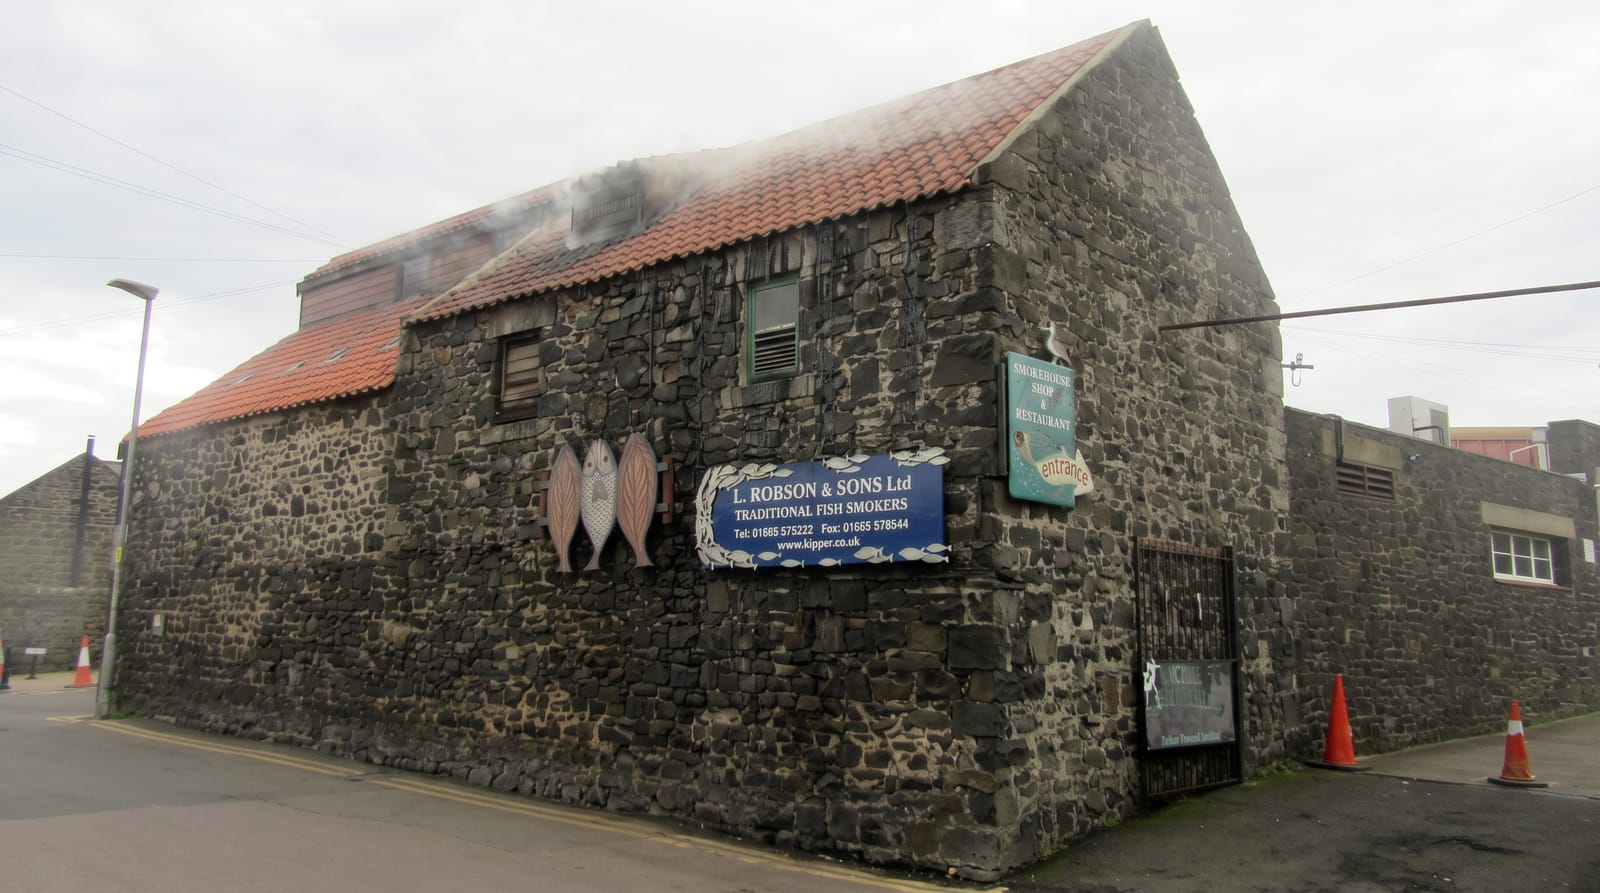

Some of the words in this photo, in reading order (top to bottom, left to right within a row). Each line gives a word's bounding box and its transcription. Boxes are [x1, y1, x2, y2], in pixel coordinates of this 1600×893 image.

[1014, 363, 1070, 387] SMOKEHOUSE
[1031, 382, 1054, 397] SHOP
[1040, 399, 1047, 410] &
[1015, 407, 1071, 431] RESTAURANT
[1042, 459, 1088, 486] entrance
[733, 488, 746, 504] L.
[751, 482, 816, 502] ROBSON
[821, 481, 832, 497] &
[836, 476, 882, 495] SONS
[887, 475, 912, 492] Ltd
[735, 504, 812, 521] TRADITIONAL
[816, 503, 843, 516] FISH
[846, 498, 908, 514] SMOKERS
[734, 528, 750, 539] Tel:
[843, 520, 871, 533] 01665
[777, 536, 860, 551] www.kipper.co.uk
